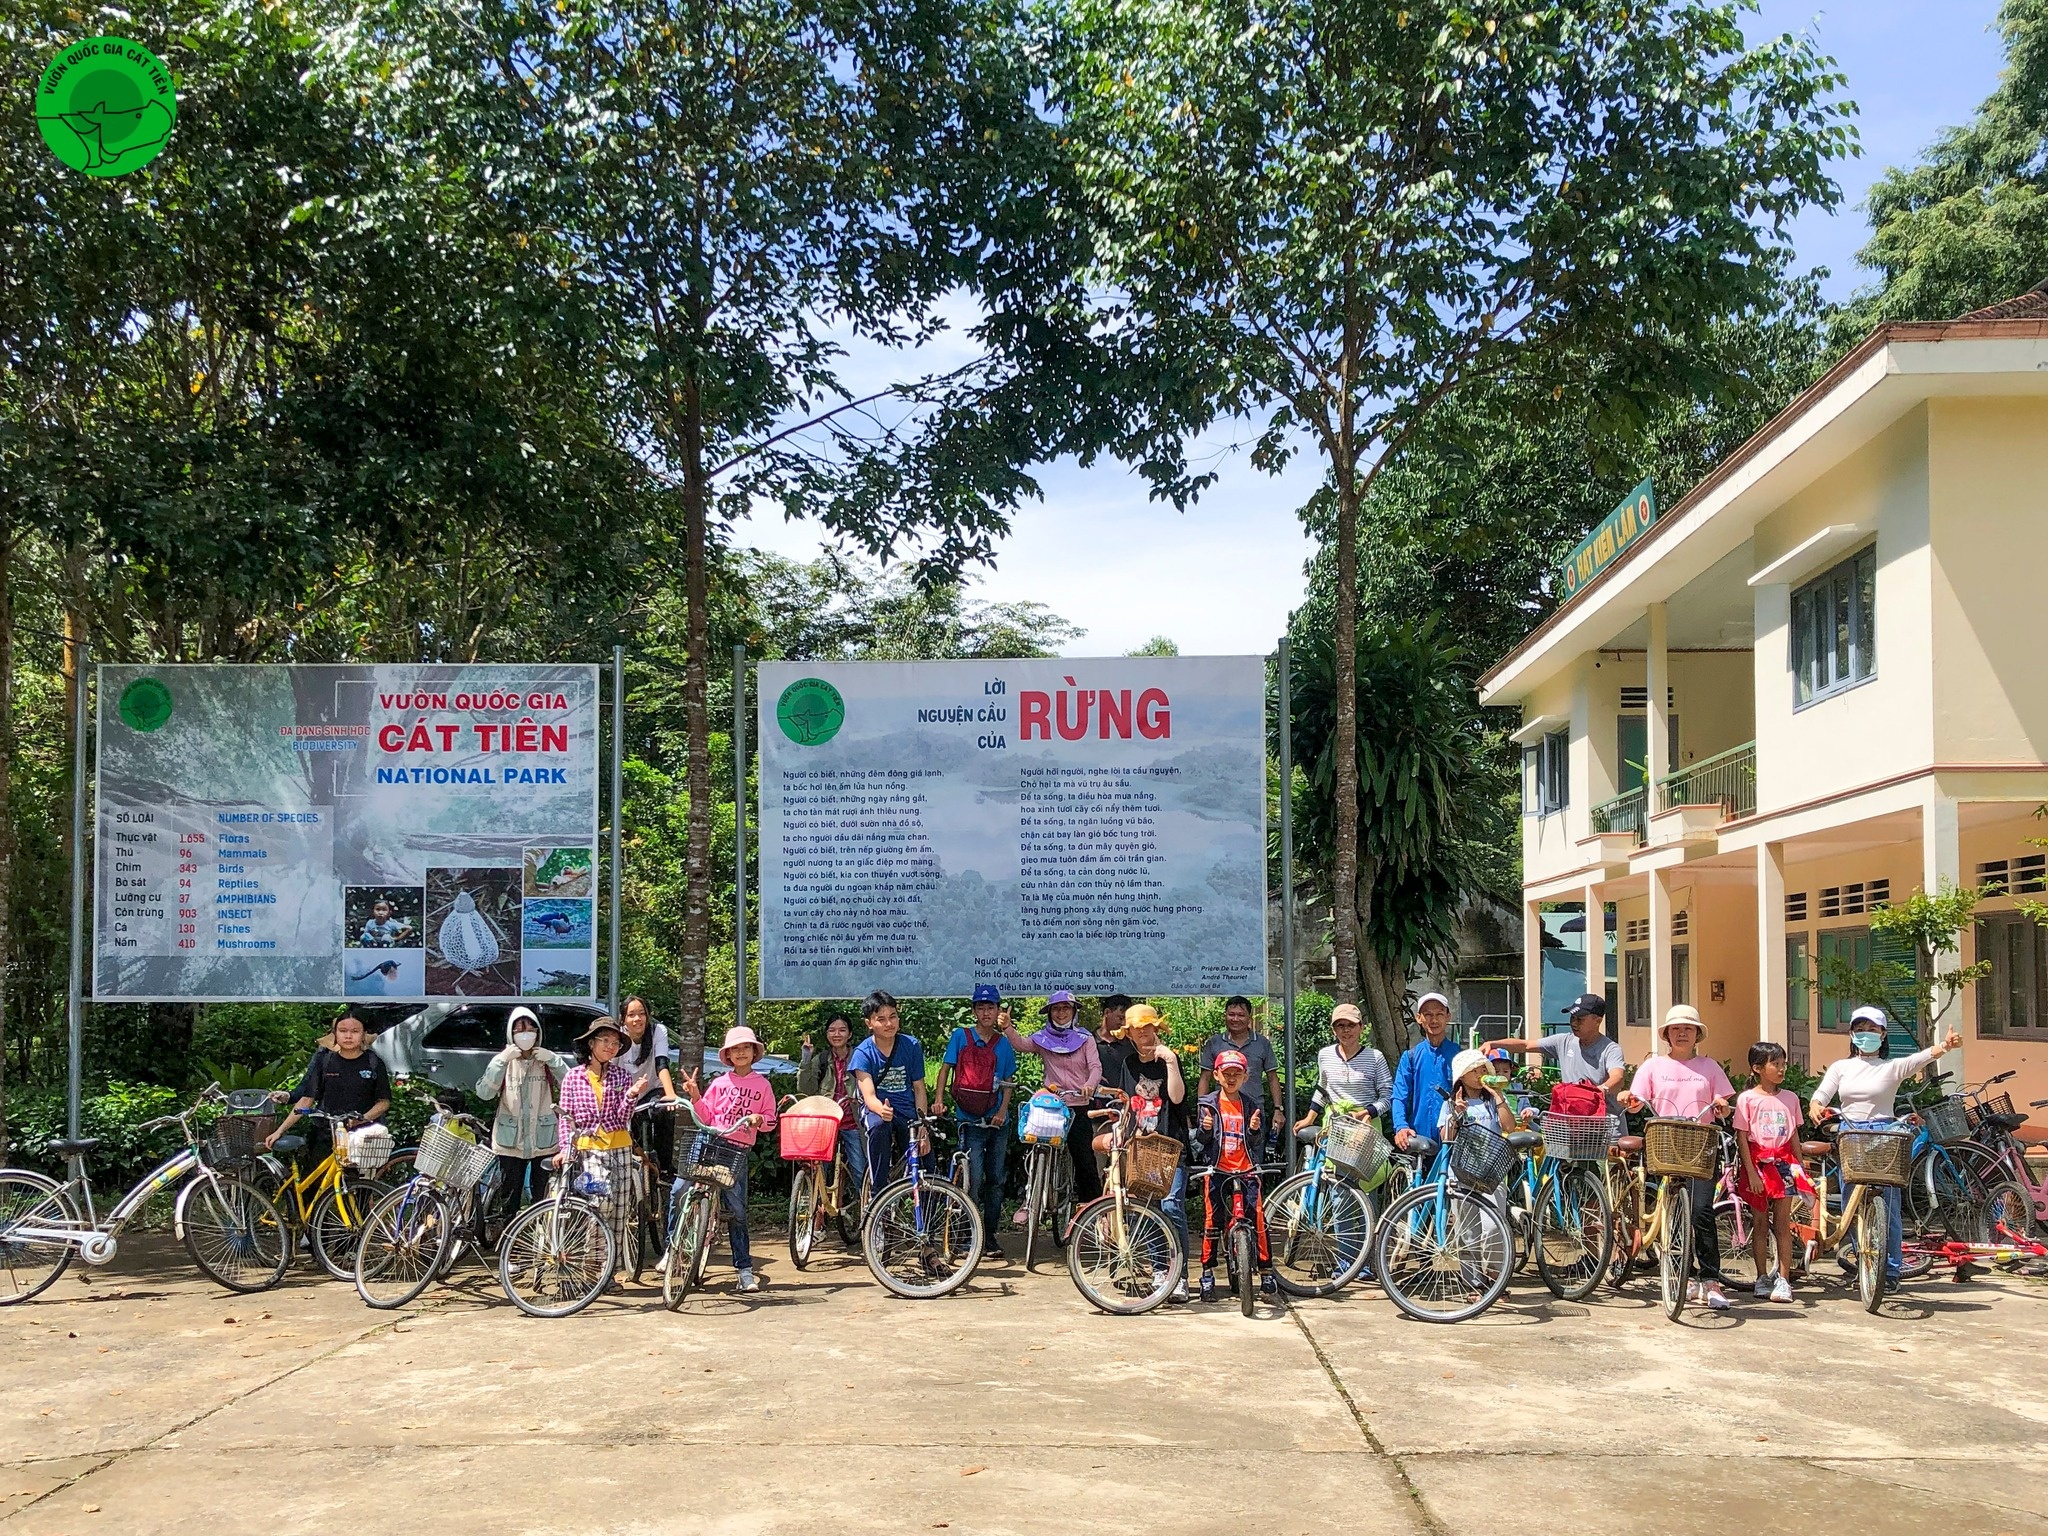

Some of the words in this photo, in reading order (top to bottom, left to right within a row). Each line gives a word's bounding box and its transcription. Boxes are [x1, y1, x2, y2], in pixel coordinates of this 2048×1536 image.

[984, 677, 1006, 695] LỜI
[380, 689, 447, 710] VƯỜN
[455, 687, 520, 710] QUỐC
[528, 693, 568, 709] GIA
[1019, 676, 1171, 740] RỪNG
[918, 704, 974, 726] NGUYỆN
[977, 701, 1006, 722] CẦU
[324, 726, 347, 736] SINH
[378, 717, 460, 752] CÁT
[474, 717, 568, 752] TIÊN
[977, 730, 1006, 750] CỦA
[292, 741, 358, 751] BIODIVERSITY
[378, 768, 496, 784] NATIONAL
[504, 768, 567, 784] PARK
[1088, 767, 1108, 777] nghe
[1122, 767, 1130, 775] ta
[1034, 793, 1041, 801] ta
[116, 811, 129, 823] SỐ
[133, 812, 154, 823] LOÀI
[218, 813, 259, 823] NUMBER
[262, 813, 274, 823] OF
[277, 813, 319, 823] SPECIES
[116, 832, 140, 844] Thực
[179, 833, 205, 843] 1.655
[219, 833, 250, 843] Floras
[180, 849, 192, 858] 96
[218, 849, 267, 858] Mammals
[116, 862, 142, 872] Chim
[179, 863, 197, 873] 343
[218, 863, 244, 873] Birds
[1034, 868, 1042, 876] ta
[1068, 868, 1076, 876] ta
[131, 877, 147, 887] sát
[179, 879, 191, 888] 94
[218, 878, 259, 890] Reptiles
[179, 894, 190, 903] 37
[216, 895, 277, 904] AMPHIBIANS
[115, 907, 136, 917] Côn
[137, 907, 164, 919] trùng
[178, 909, 197, 919] 903
[218, 909, 253, 919] INSECT
[1064, 906, 1090, 915] phong
[1176, 905, 1204, 915] phong.
[115, 922, 127, 932] Cá
[178, 924, 195, 933] 130
[217, 924, 250, 933] Fishes
[810, 921, 817, 929] ta
[114, 937, 137, 947] Nấm
[178, 939, 196, 949] 410
[217, 939, 276, 949] Mushrooms
[1076, 984, 1092, 992] suy
[720, 1086, 762, 1101] WOULD
[729, 1096, 751, 1108] YOU
